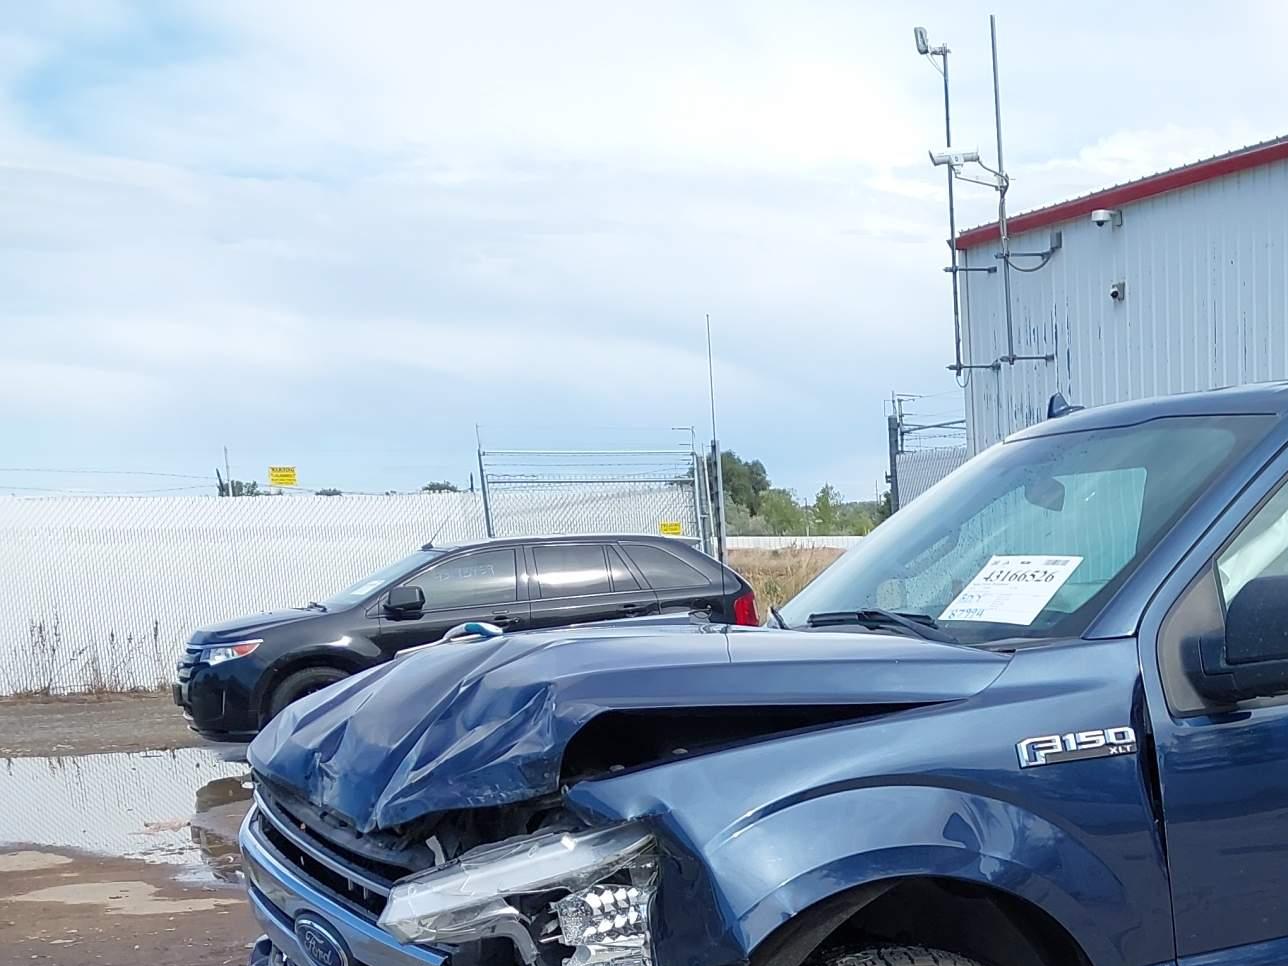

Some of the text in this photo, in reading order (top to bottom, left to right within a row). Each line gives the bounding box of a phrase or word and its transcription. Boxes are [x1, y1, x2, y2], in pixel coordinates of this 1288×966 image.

[983, 570, 1057, 583] 43166526
[1016, 726, 1137, 769] F150
[1108, 744, 1133, 755] XLT
[304, 930, 334, 966] Ford
